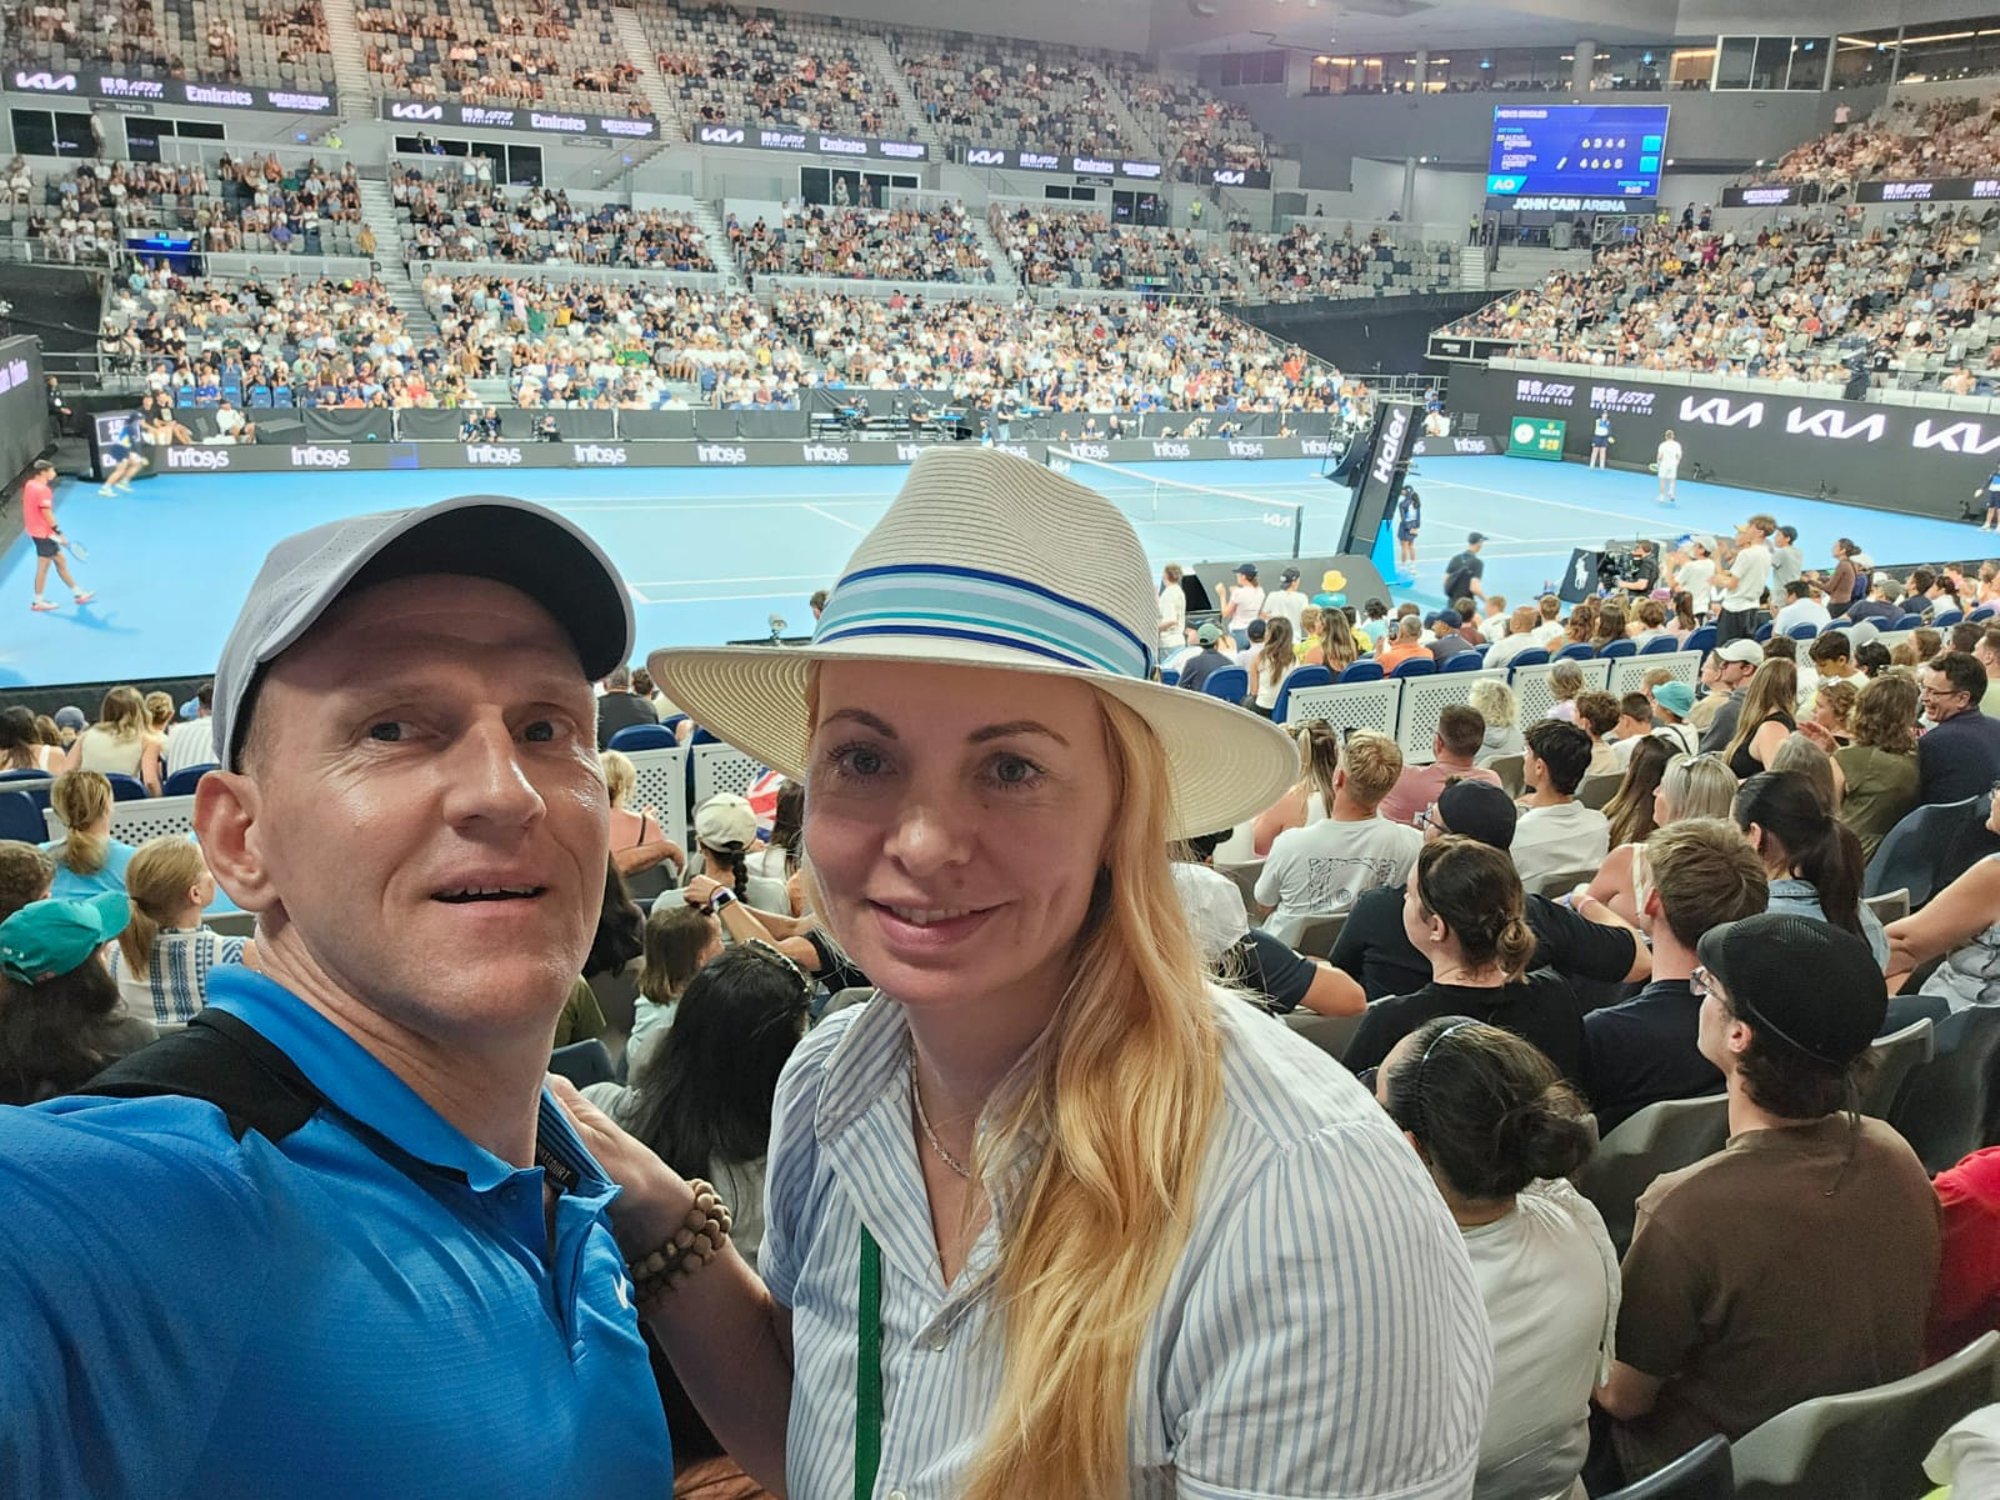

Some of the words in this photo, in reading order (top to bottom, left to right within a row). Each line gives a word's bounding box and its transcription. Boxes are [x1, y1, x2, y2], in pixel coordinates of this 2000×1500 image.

[16, 71, 77, 91] KIA
[185, 85, 252, 106] Emirates
[391, 102, 443, 119] KIA
[531, 113, 587, 132] Emirates
[701, 127, 744, 144] KIA
[1581, 138, 1590, 148] 6
[1605, 138, 1614, 148] 4
[1617, 138, 1626, 148] 4
[819, 137, 867, 155] Emirates
[1073, 158, 1115, 174] Emirates
[1579, 158, 1588, 168] 4
[1591, 158, 1600, 168] 6
[1602, 158, 1611, 168] 6
[1512, 197, 1548, 210] JOHN
[1549, 197, 1581, 211] CAIN
[1582, 199, 1627, 212] ARENA
[1679, 394, 1764, 429] KIA
[1786, 406, 1886, 442] KIA
[467, 444, 522, 466] Infosys
[574, 444, 627, 465] Infosys
[697, 444, 746, 465] Infosys
[803, 444, 849, 464] Infosys
[1070, 442, 1109, 459] Infosys
[1152, 441, 1190, 459] Infosys
[1373, 409, 1406, 484] Haier
[1454, 438, 1486, 454] Infosys
[167, 447, 229, 469] Infosys
[291, 446, 350, 468] Infosys
